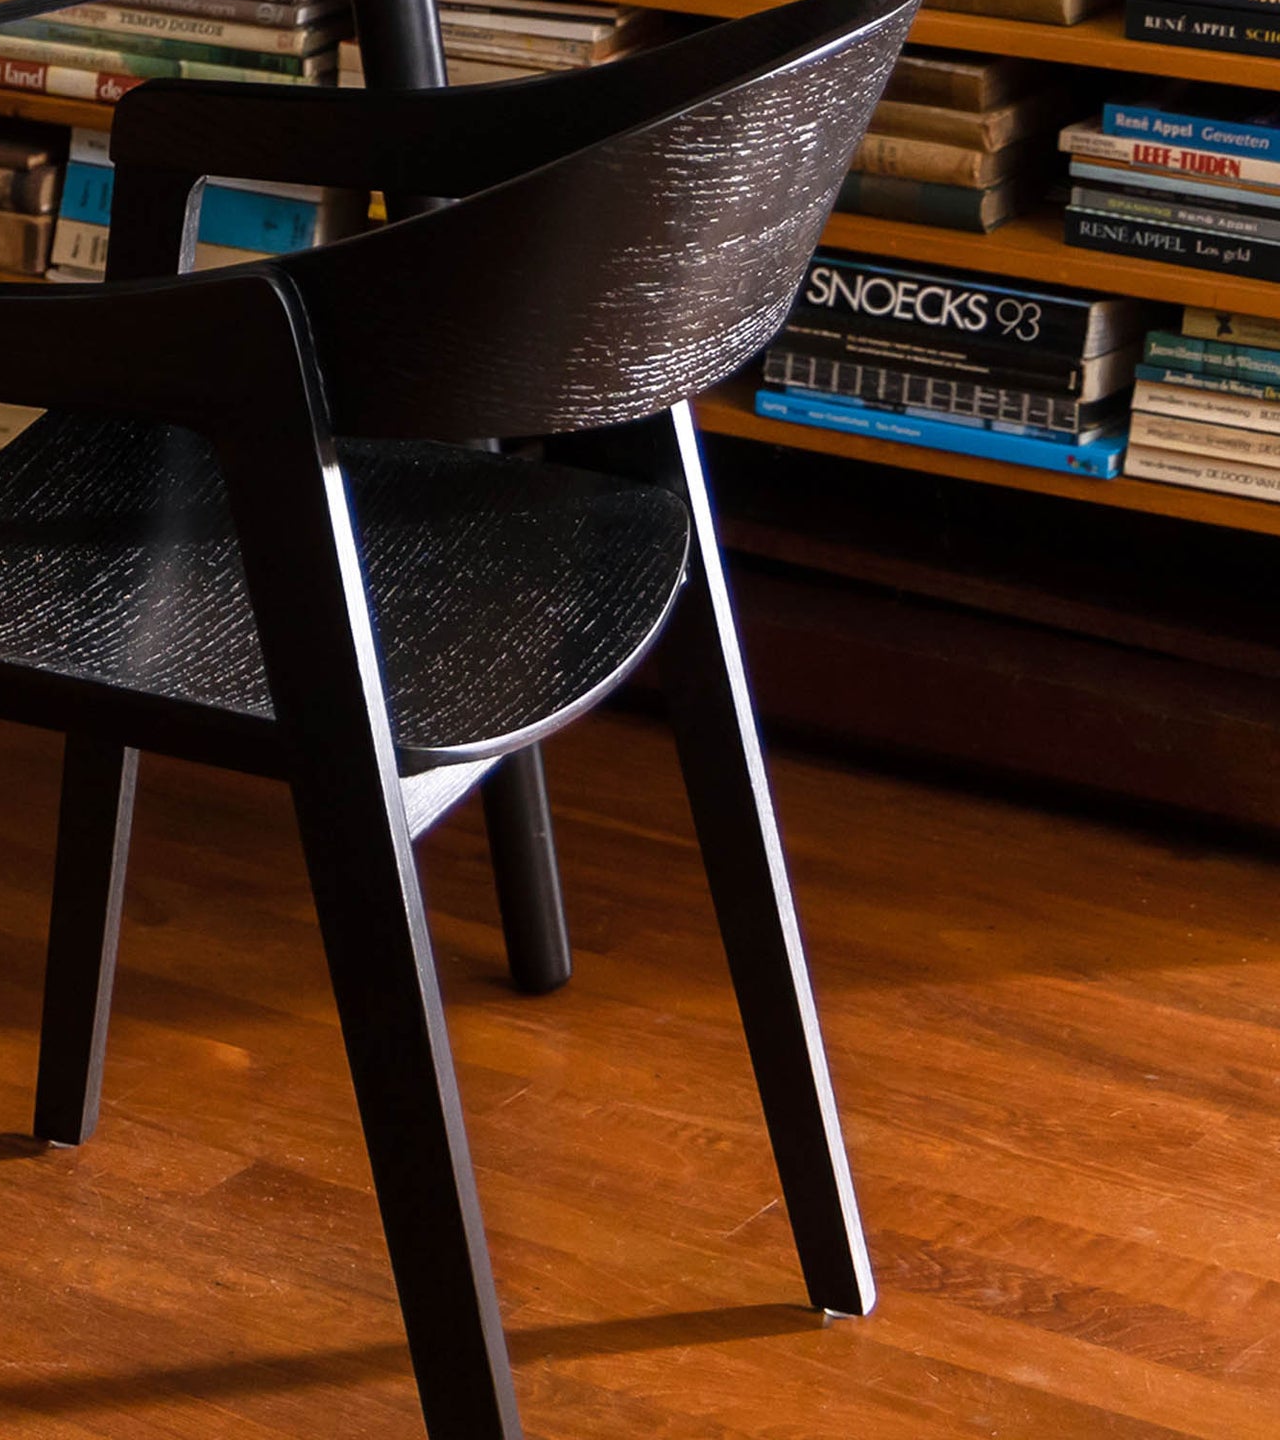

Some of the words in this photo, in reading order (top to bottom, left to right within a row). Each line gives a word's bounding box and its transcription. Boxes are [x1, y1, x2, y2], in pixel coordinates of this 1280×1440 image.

[1144, 14, 1187, 33] RENÉ
[1191, 21, 1237, 39] APPEL
[6, 64, 45, 91] land
[1114, 112, 1149, 131] René
[1152, 119, 1193, 139] Appel
[1200, 126, 1270, 150] Geweten
[1177, 209, 1215, 226] René
[1218, 216, 1258, 233] Appel
[1079, 220, 1129, 243] RENÉ
[1130, 231, 1188, 253] APPEL
[1196, 240, 1220, 257] Los
[1222, 246, 1252, 263] geld
[806, 265, 992, 333] SNOECKS
[996, 298, 1047, 343] 93
[1205, 467, 1218, 480] DE
[1218, 468, 1253, 485] DOOD
